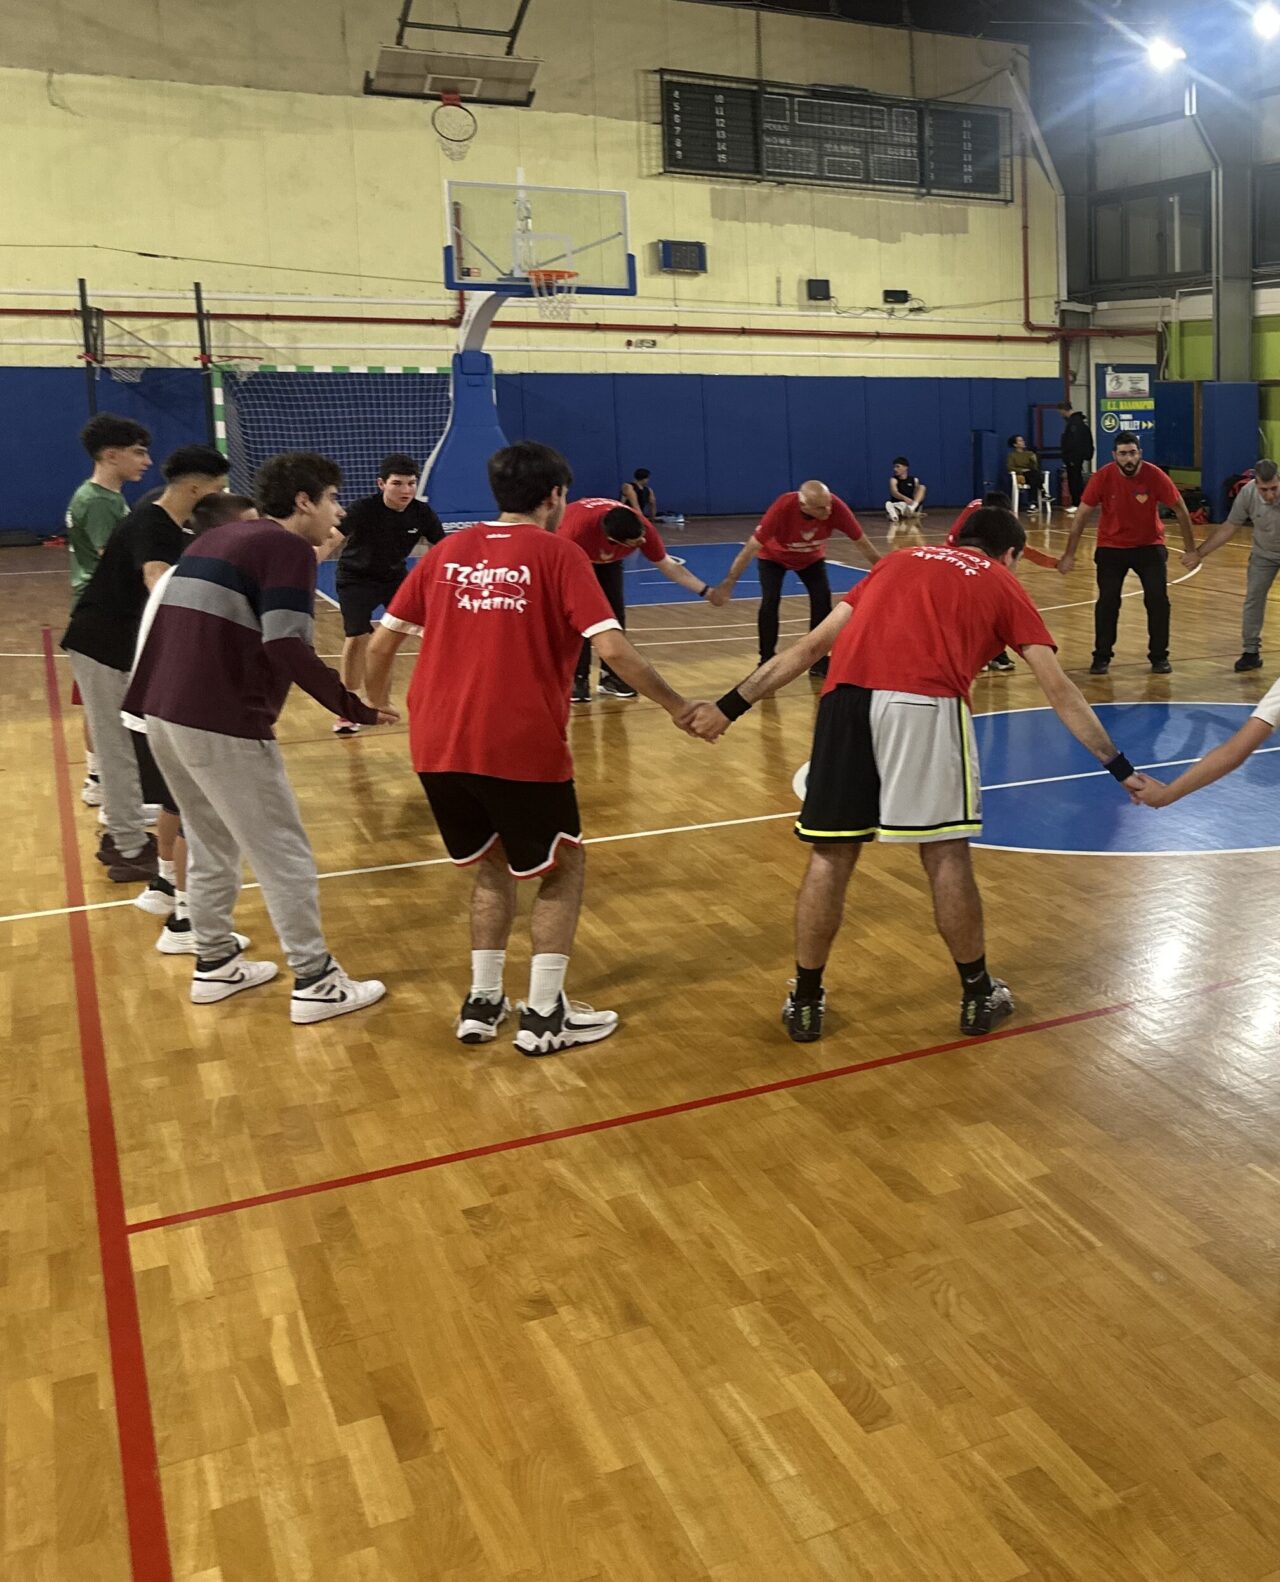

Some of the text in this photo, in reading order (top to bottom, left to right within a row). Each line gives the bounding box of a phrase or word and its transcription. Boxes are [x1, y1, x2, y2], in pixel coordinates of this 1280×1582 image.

[673, 101, 680, 111] 5
[716, 118, 726, 127] 12
[673, 126, 682, 135] 7
[717, 154, 728, 163] 15
